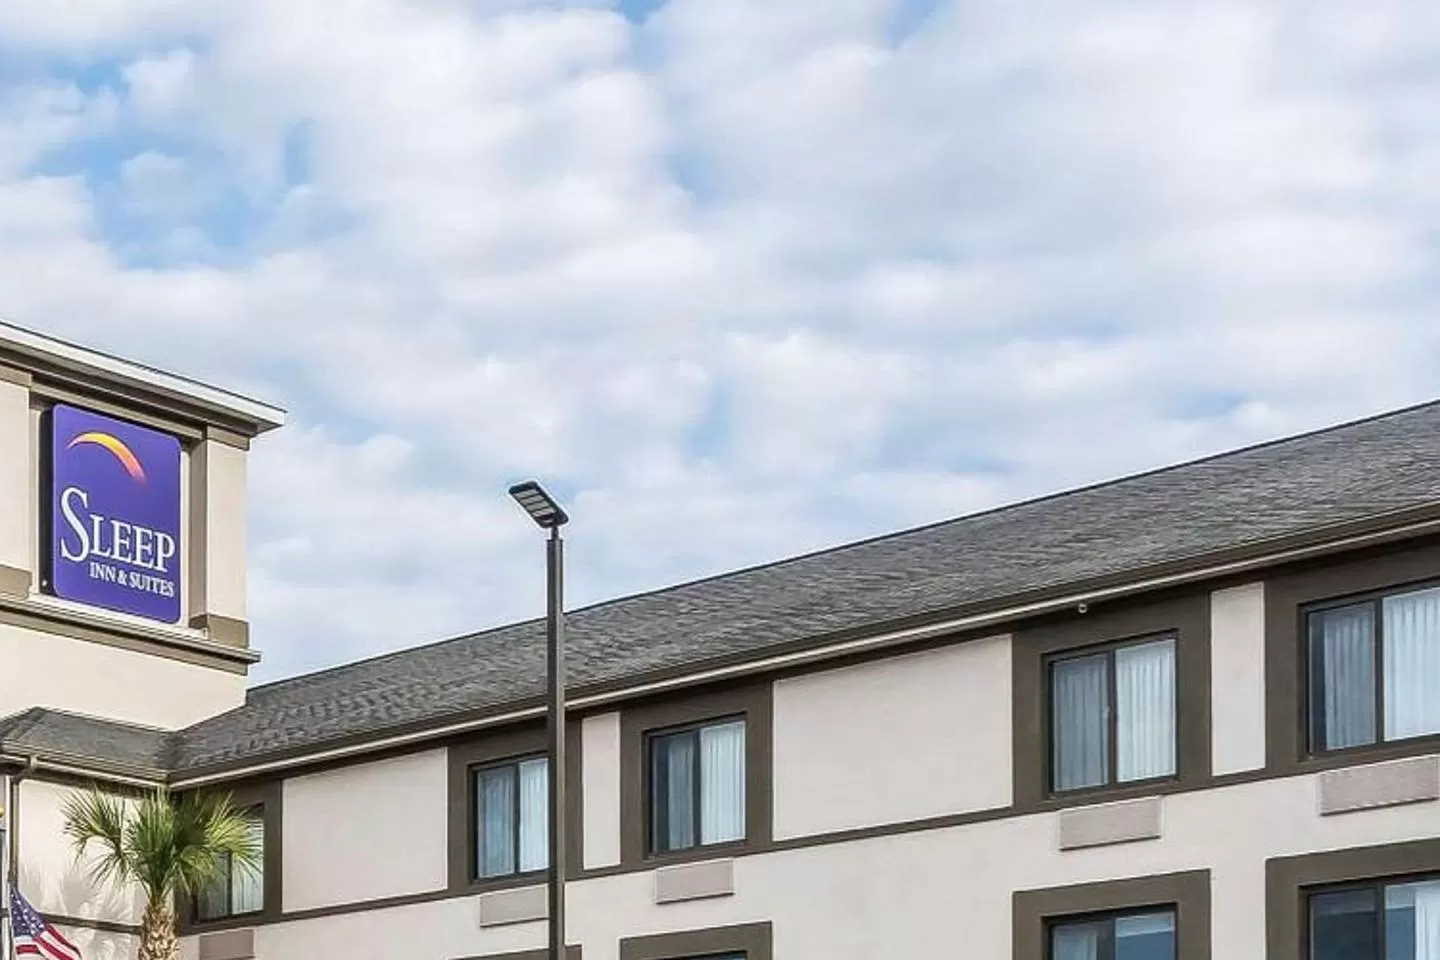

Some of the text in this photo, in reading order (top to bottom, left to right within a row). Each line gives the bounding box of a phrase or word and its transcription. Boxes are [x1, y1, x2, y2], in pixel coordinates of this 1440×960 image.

[61, 487, 175, 572] SLEEP
[89, 562, 174, 597] INN & SUITES
